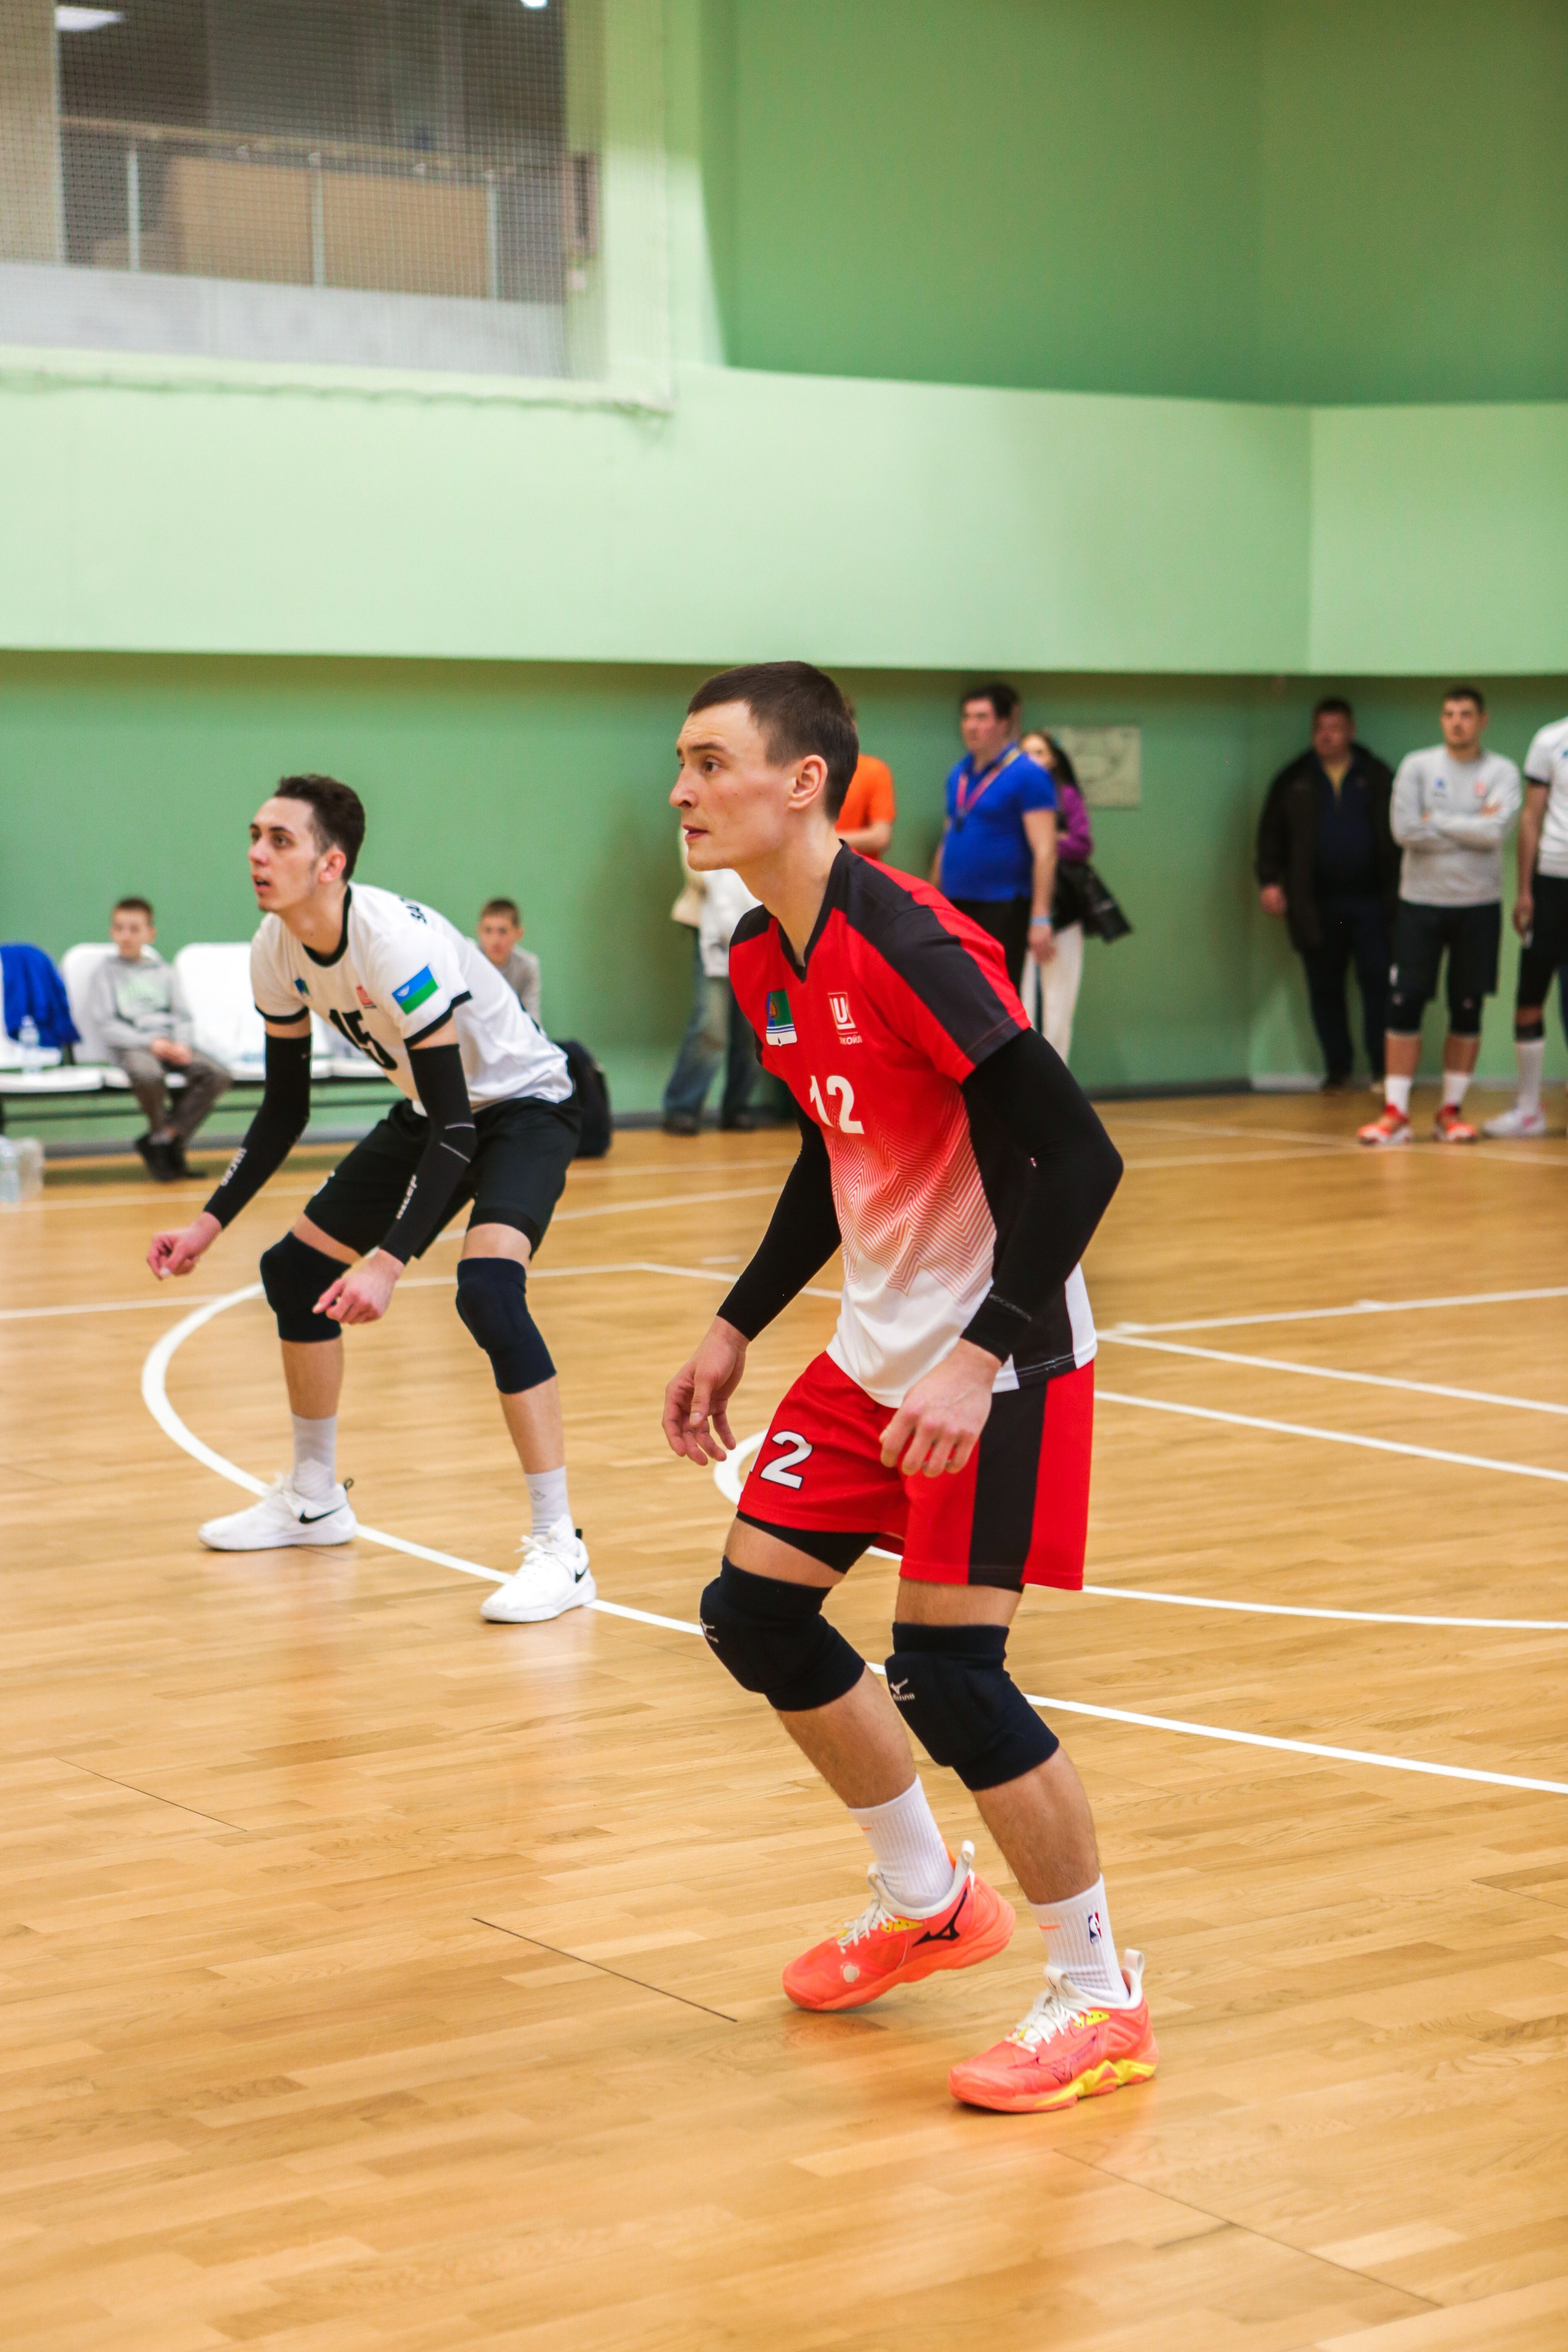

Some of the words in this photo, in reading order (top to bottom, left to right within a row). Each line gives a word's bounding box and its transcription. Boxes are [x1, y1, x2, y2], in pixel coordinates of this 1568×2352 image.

[329, 1008, 398, 1071] 15
[809, 1074, 865, 1135] 12
[749, 1430, 814, 1490] 2
